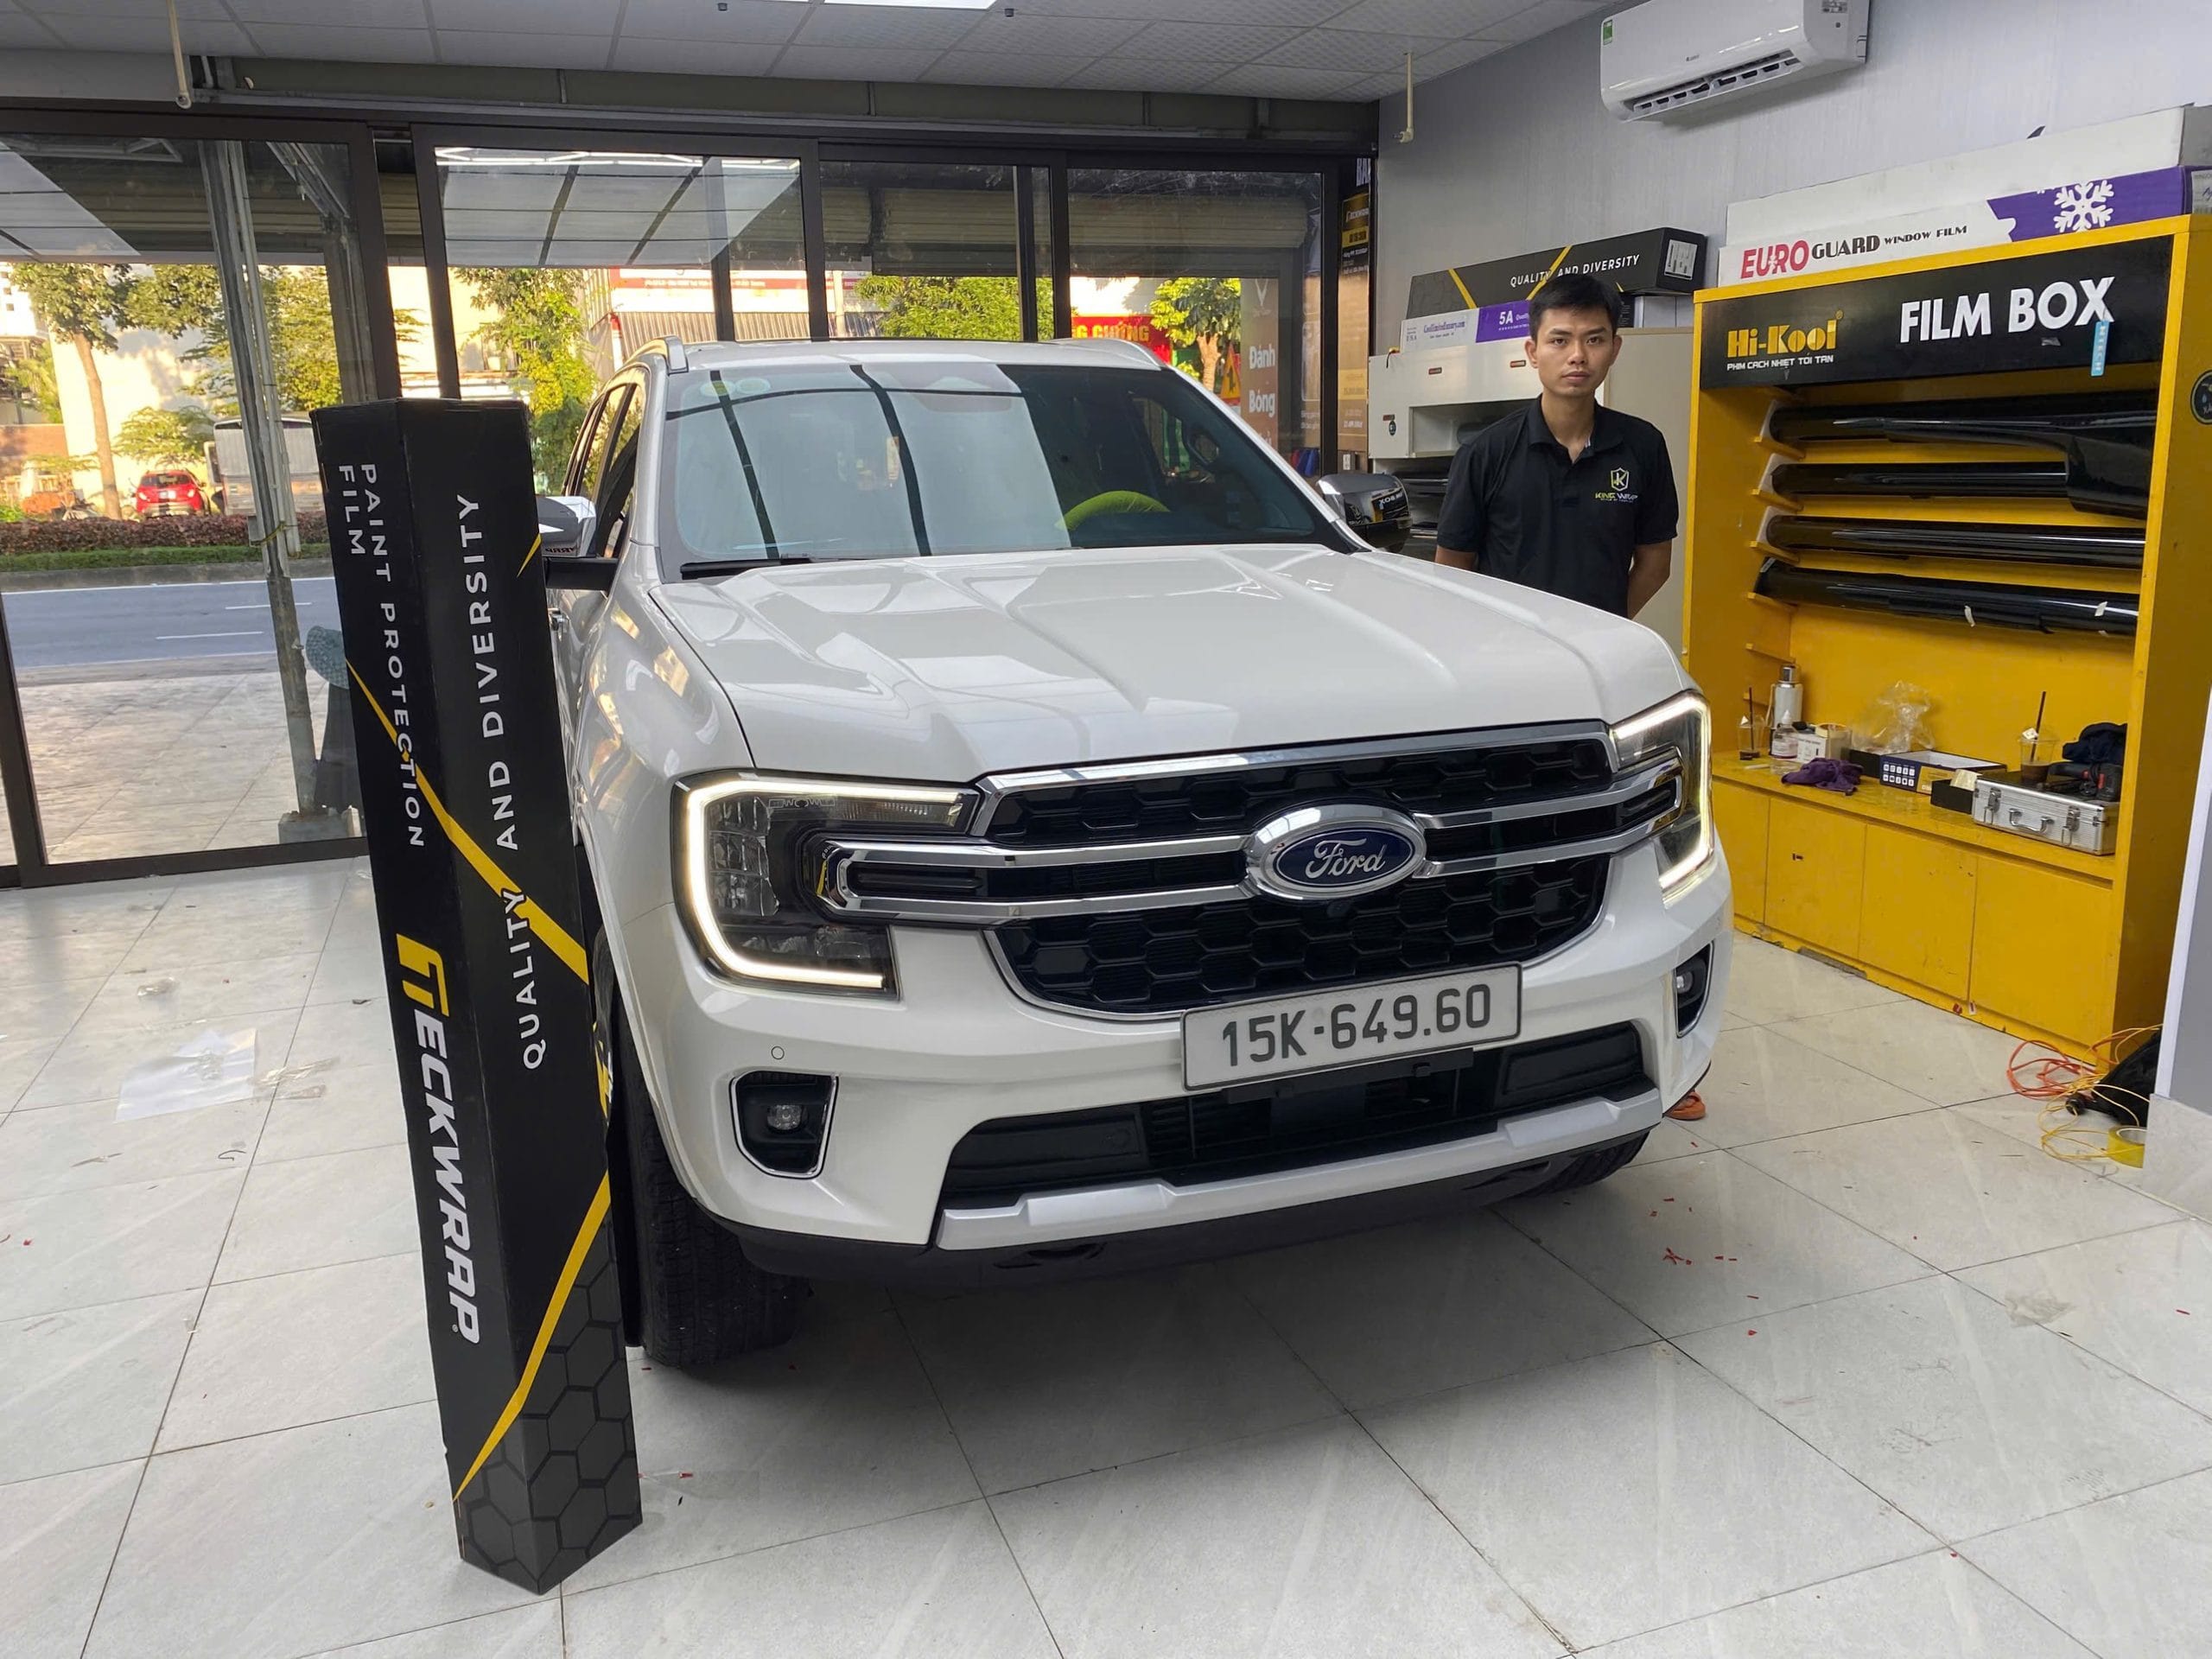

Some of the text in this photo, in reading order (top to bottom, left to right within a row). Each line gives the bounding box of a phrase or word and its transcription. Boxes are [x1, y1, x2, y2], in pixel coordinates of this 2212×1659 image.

[1510, 270, 1551, 288] QUALITY
[1583, 254, 1640, 275] DIVERSITY
[1740, 225, 1967, 279] EURO GUARD WINDOW FILM
[1499, 310, 1513, 325] 5A
[1900, 276, 2115, 343] FILM BOX
[1249, 344, 1275, 369] Đánh
[1726, 362, 1745, 372] PHIM
[1249, 389, 1275, 417] Bóng
[339, 465, 366, 555] FILM
[361, 463, 426, 847] PAINT PROTECTION
[457, 494, 547, 1071] QUALITY AND DIVERSITY
[1306, 837, 1386, 879] Ford
[1223, 983, 1491, 1067] 15K-649.60
[396, 933, 481, 1345] TECKWRAP
